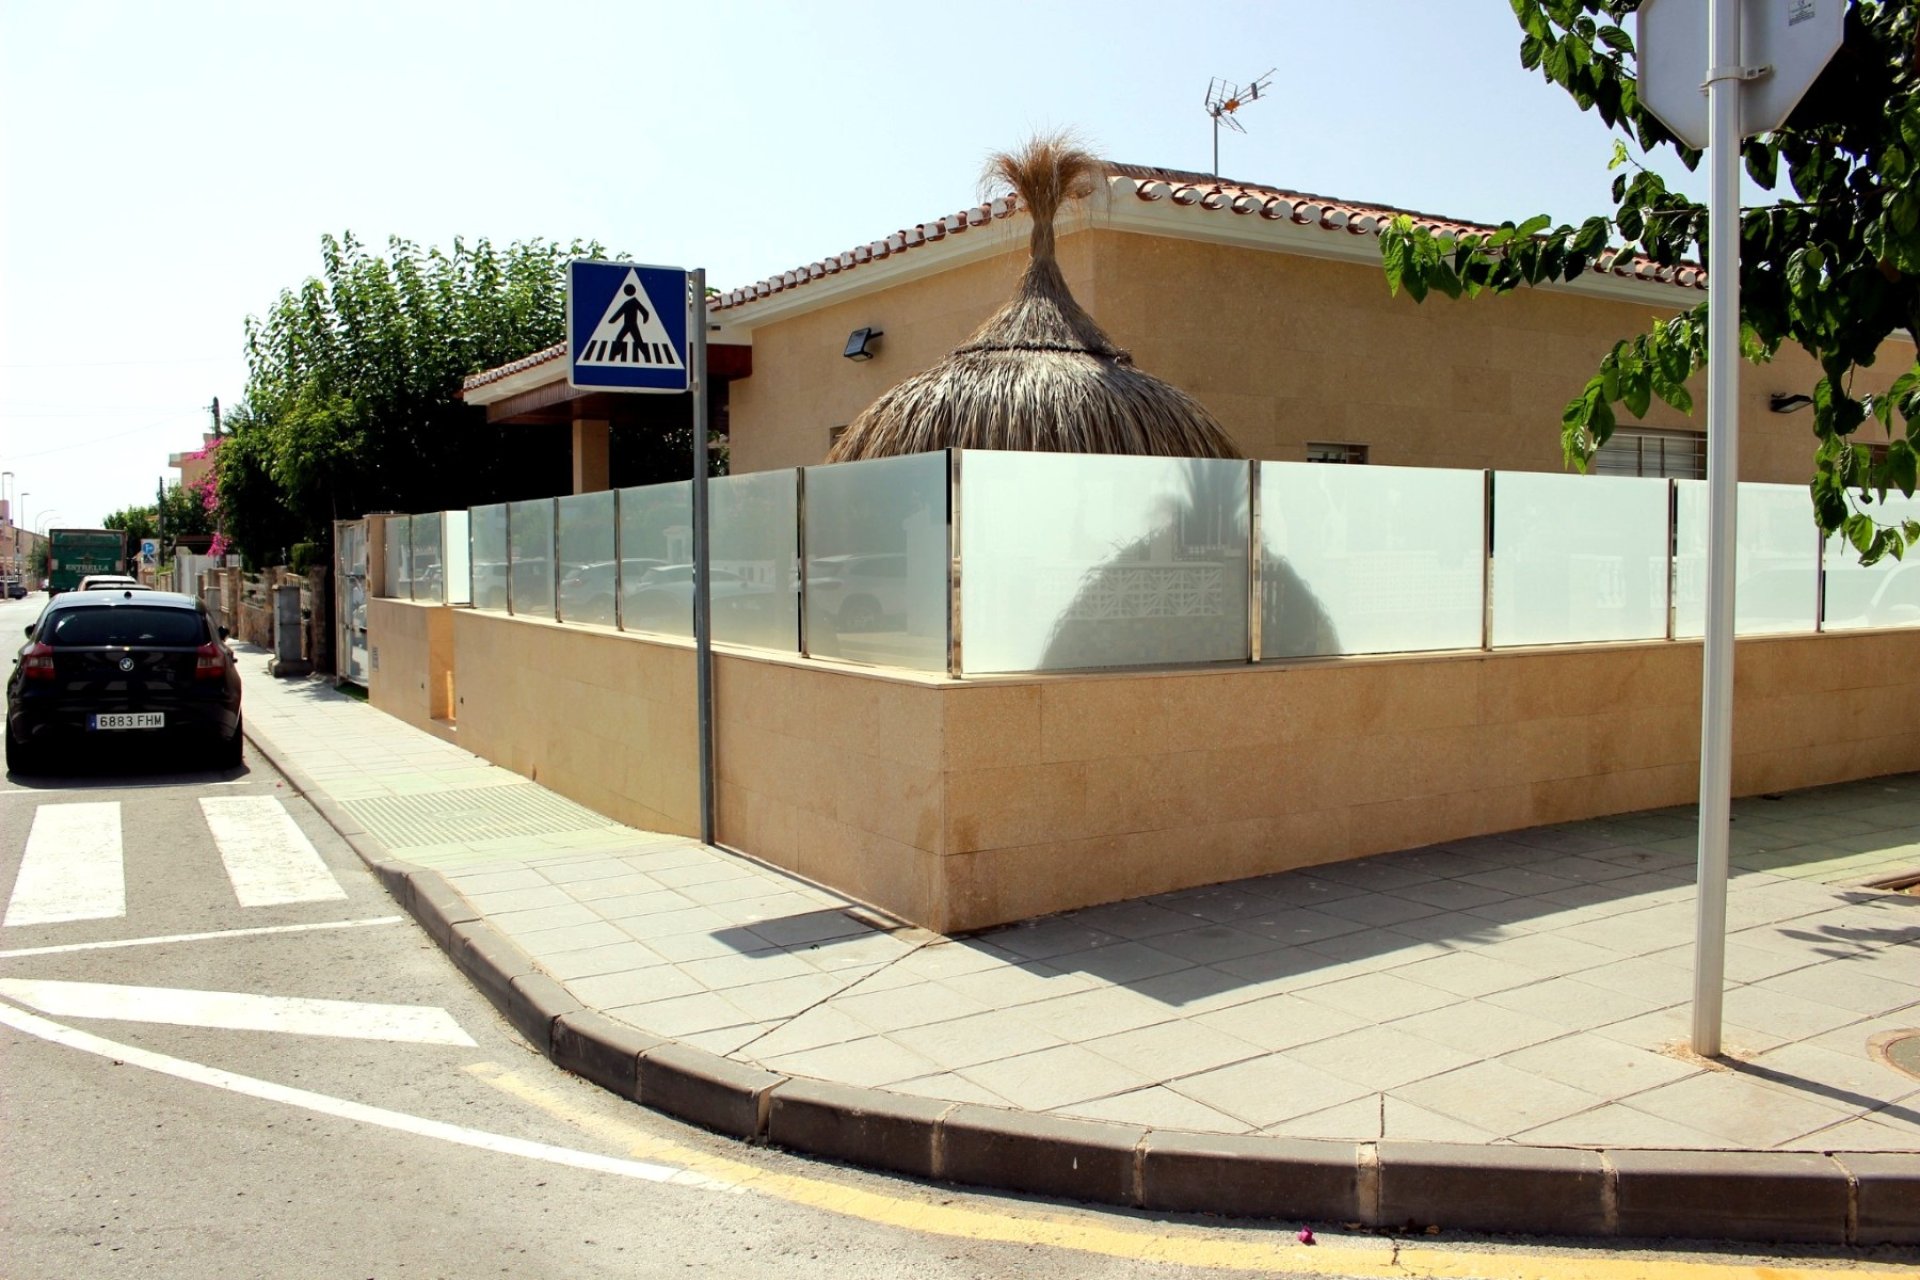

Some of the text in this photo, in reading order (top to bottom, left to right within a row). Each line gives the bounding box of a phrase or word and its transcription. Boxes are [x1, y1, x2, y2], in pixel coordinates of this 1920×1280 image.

[65, 563, 109, 571] ESTRELLA
[100, 716, 133, 727] 6883
[137, 715, 162, 726] FHM
